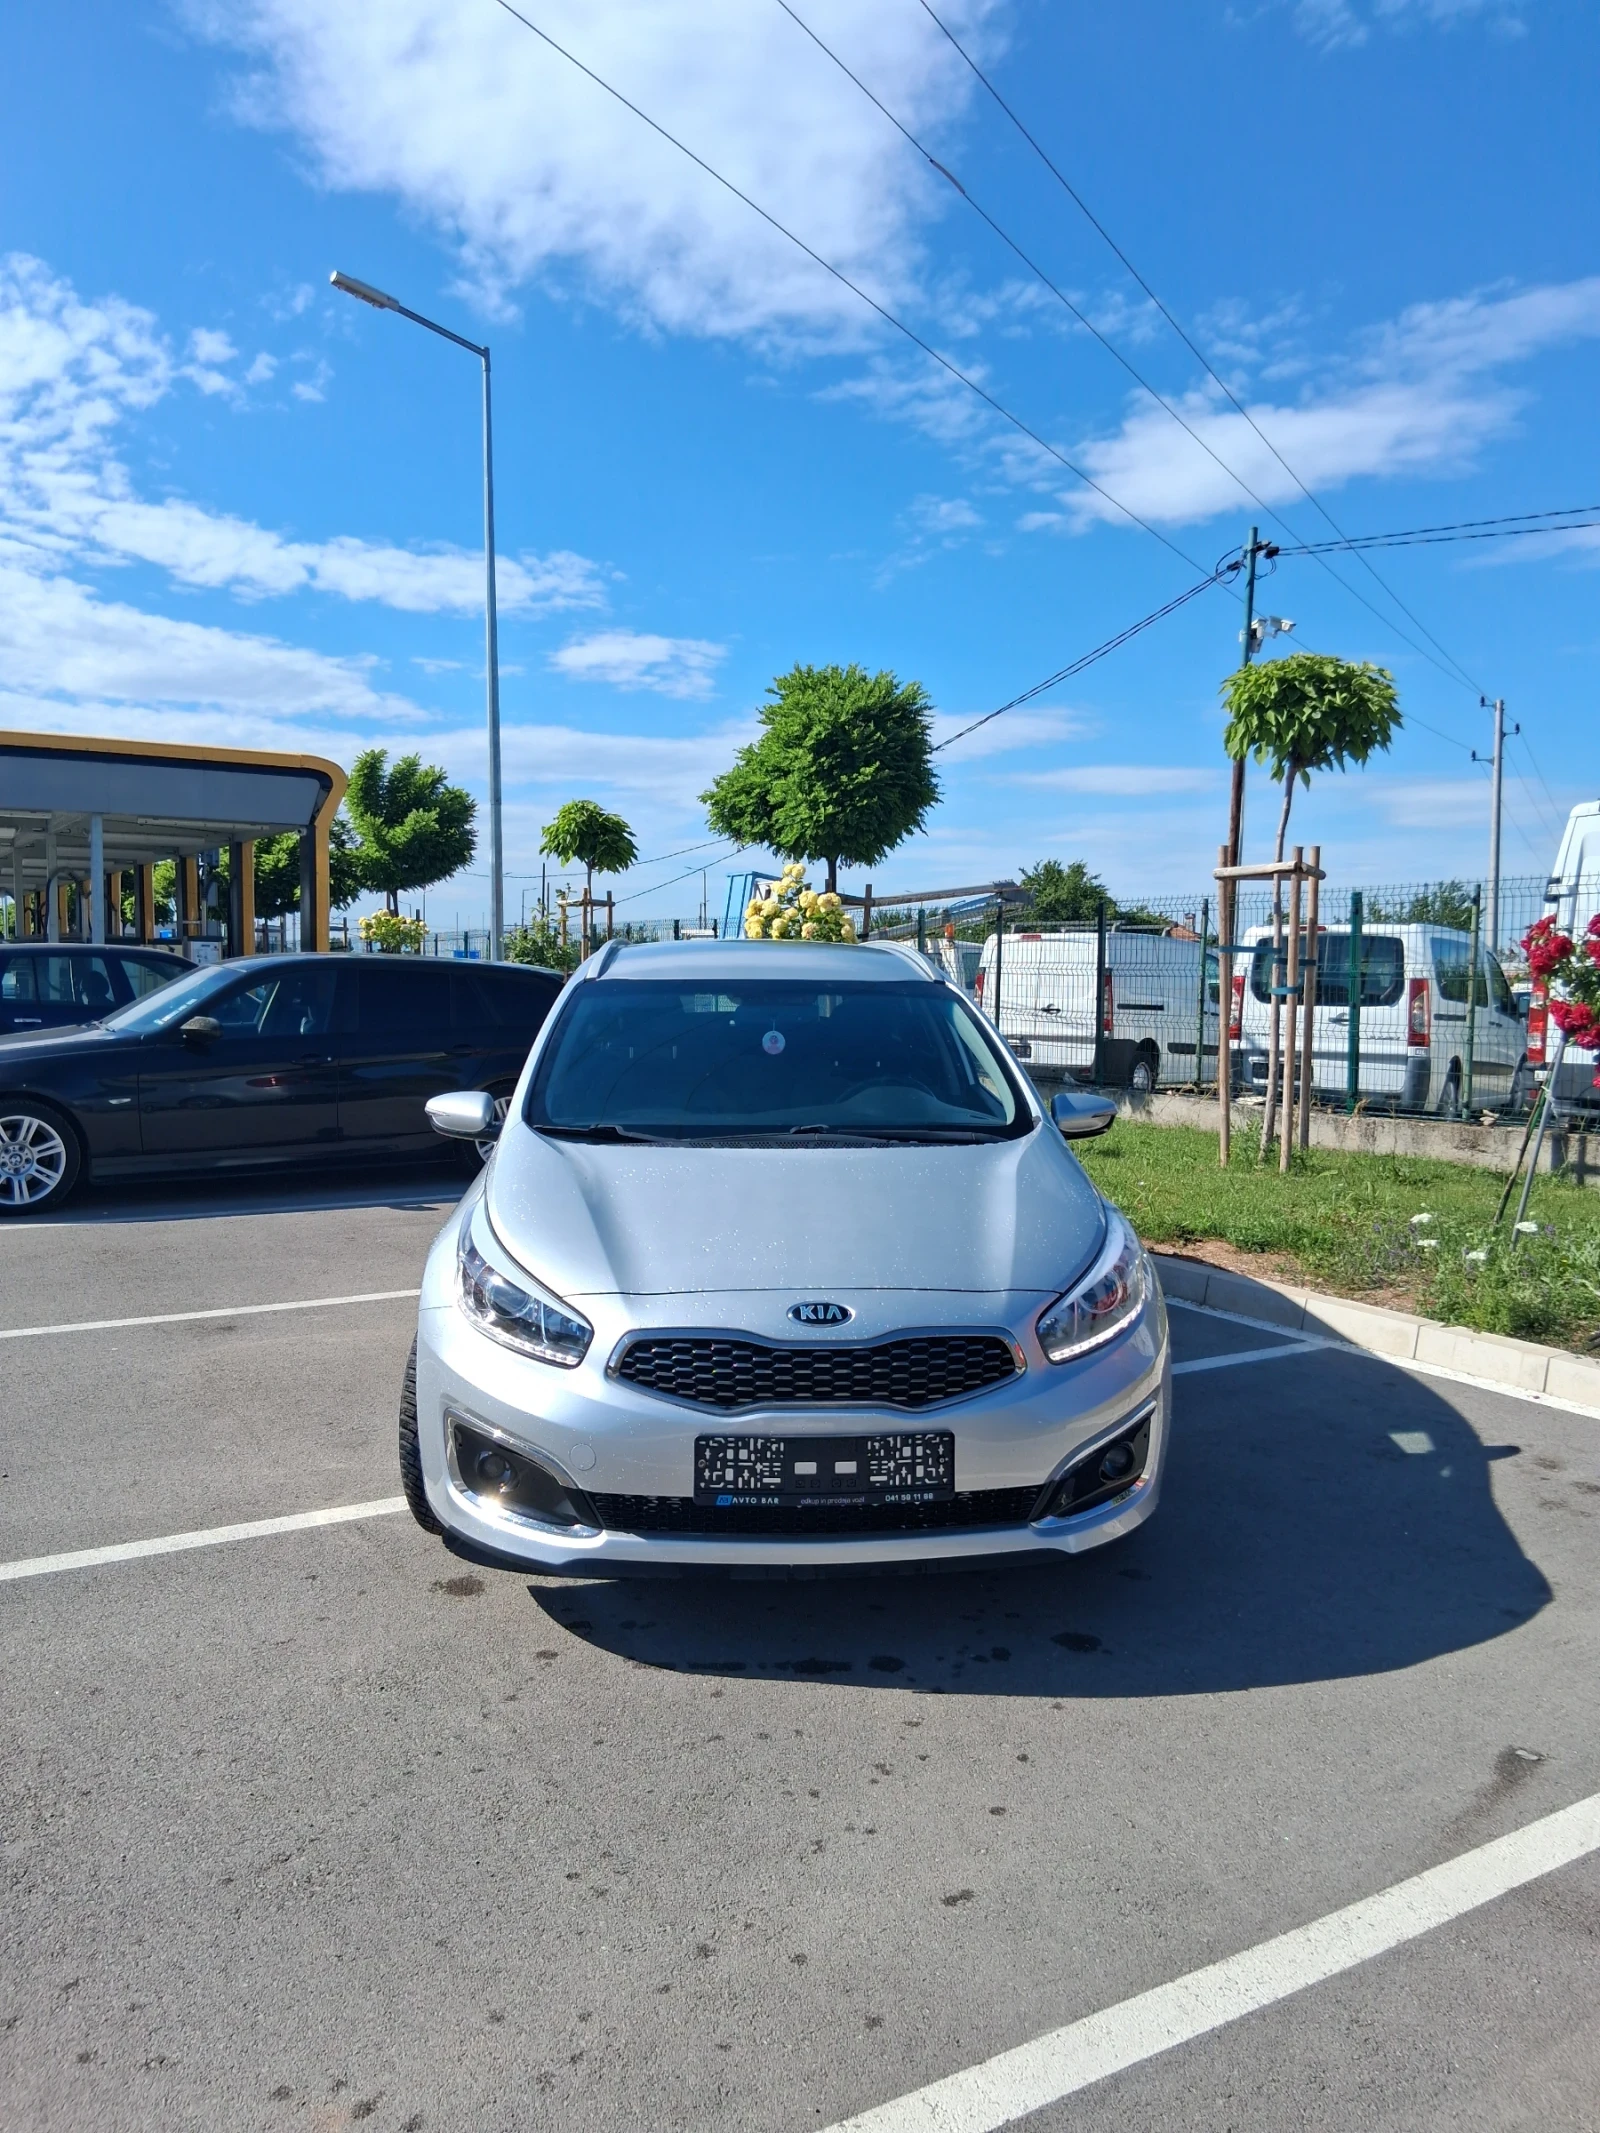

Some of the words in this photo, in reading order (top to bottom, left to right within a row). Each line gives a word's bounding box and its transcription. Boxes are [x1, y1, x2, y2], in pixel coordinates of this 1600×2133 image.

[799, 1305, 842, 1320] KIA
[885, 1494, 899, 1502] 041
[913, 1493, 921, 1501] 11
